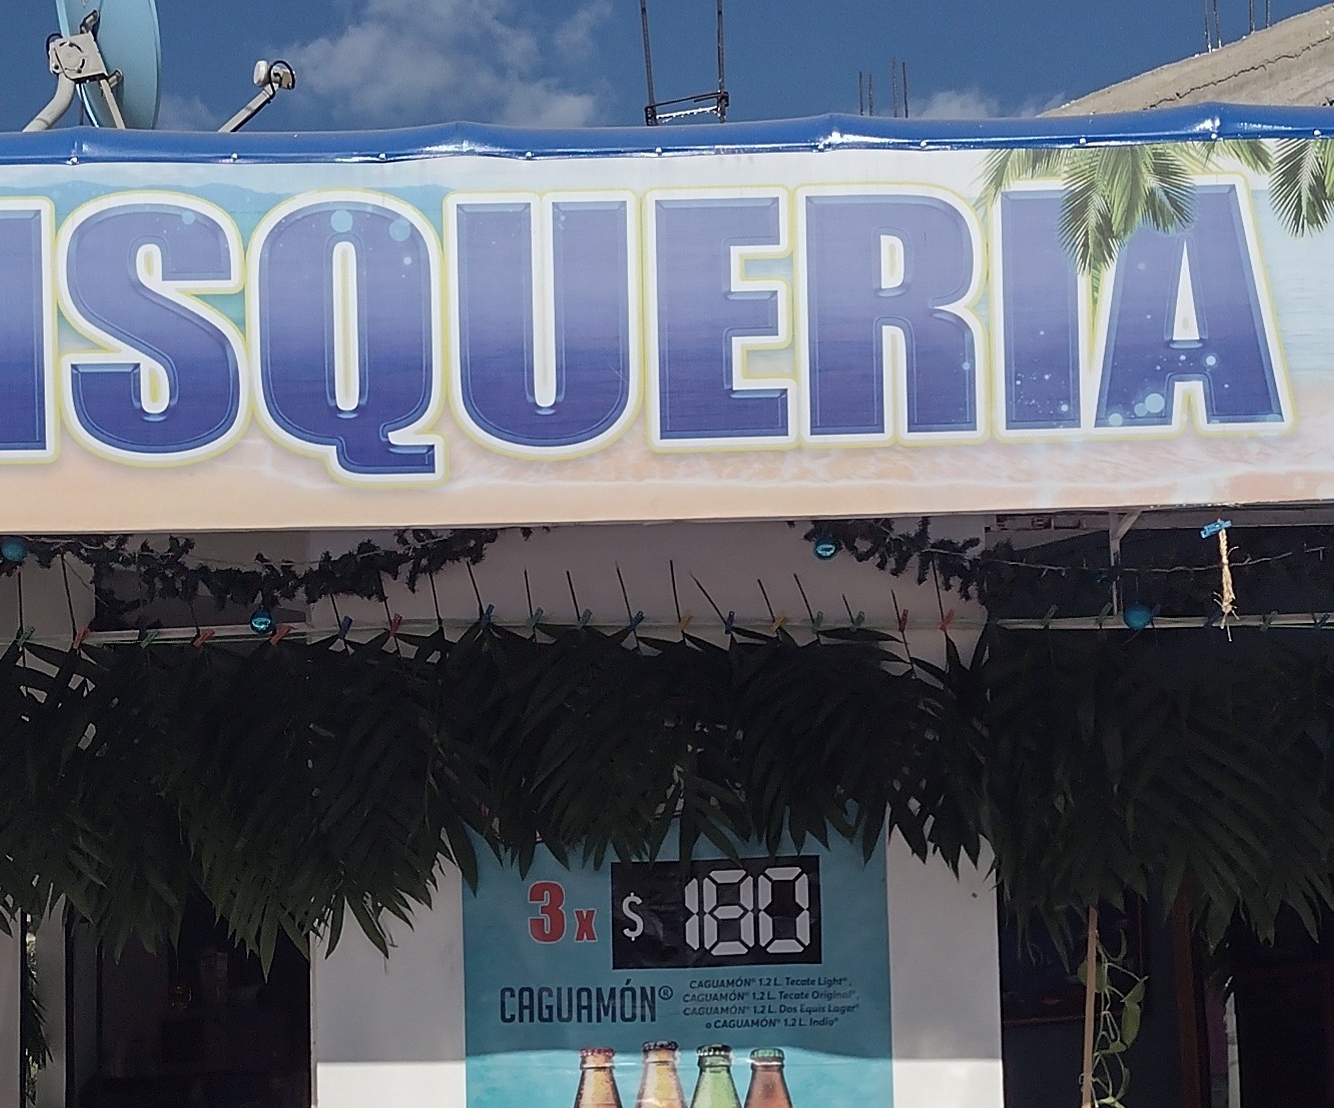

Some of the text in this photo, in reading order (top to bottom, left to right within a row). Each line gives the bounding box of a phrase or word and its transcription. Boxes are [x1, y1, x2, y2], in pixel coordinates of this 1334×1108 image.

[684, 866, 811, 956] 180
[785, 976, 816, 987] Tecate
[778, 990, 810, 1000] Tecate
[779, 1004, 798, 1014] Dos
